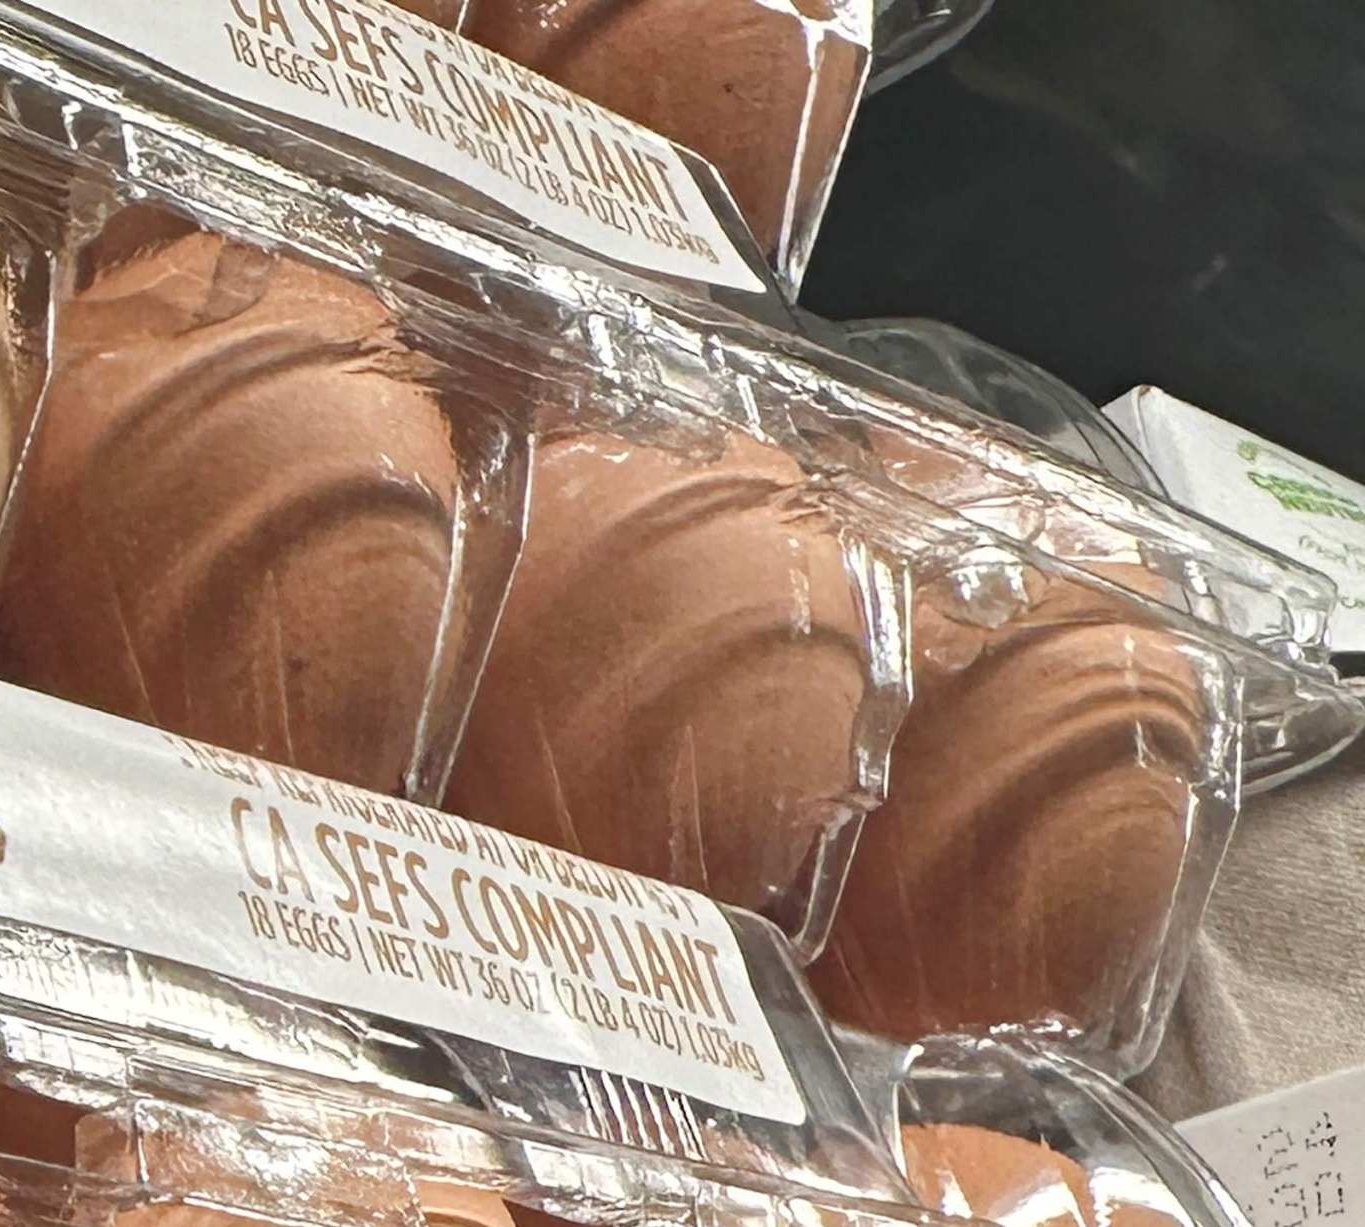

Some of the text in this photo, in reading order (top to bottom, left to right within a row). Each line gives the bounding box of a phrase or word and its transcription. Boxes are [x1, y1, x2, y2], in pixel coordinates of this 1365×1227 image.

[224, 23, 257, 69] 18
[258, 38, 330, 97] EGGS
[345, 73, 400, 123] NET
[400, 92, 446, 141] WT
[571, 181, 589, 217] 4
[299, 0, 424, 96] SEFS
[424, 50, 689, 222] COMPLIANT
[230, 796, 737, 1026] CA SEFS COMPLIANT
[238, 890, 277, 941] 18
[275, 900, 352, 962] EGGS
[367, 926, 424, 983] NET
[422, 941, 473, 997] WT
[471, 955, 511, 1006] 36
[510, 967, 551, 1015] OZ
[551, 971, 587, 1023] (2
[581, 983, 619, 1032] LB
[621, 996, 641, 1038] 4
[639, 1000, 683, 1056] OZ)
